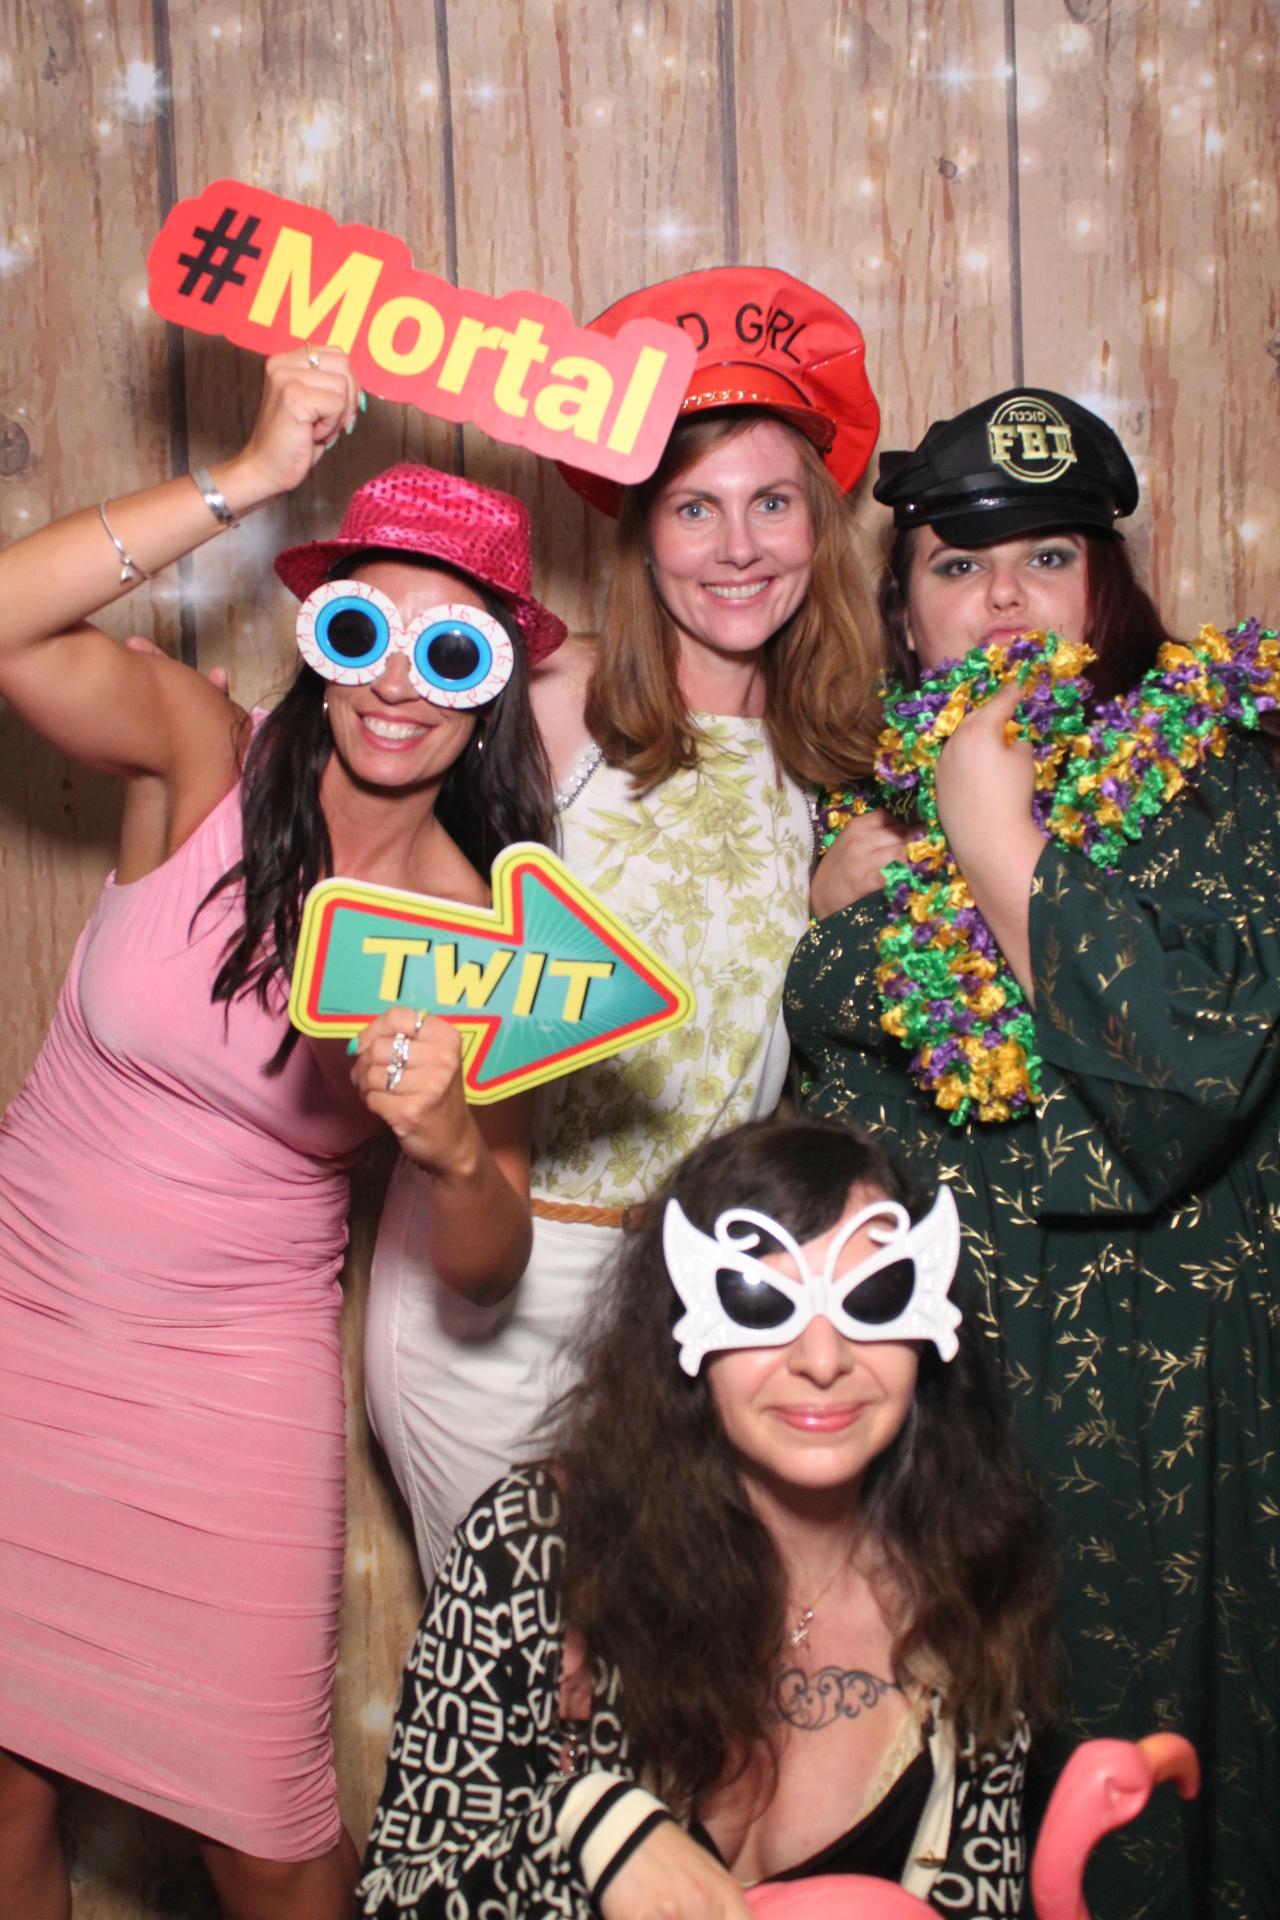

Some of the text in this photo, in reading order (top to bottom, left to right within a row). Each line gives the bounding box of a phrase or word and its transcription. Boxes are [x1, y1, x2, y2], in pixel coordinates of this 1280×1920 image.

[177, 206, 668, 456] #Mortal
[735, 303, 808, 364] GRL
[987, 421, 1078, 464] FBI
[361, 936, 616, 1025] TWIT
